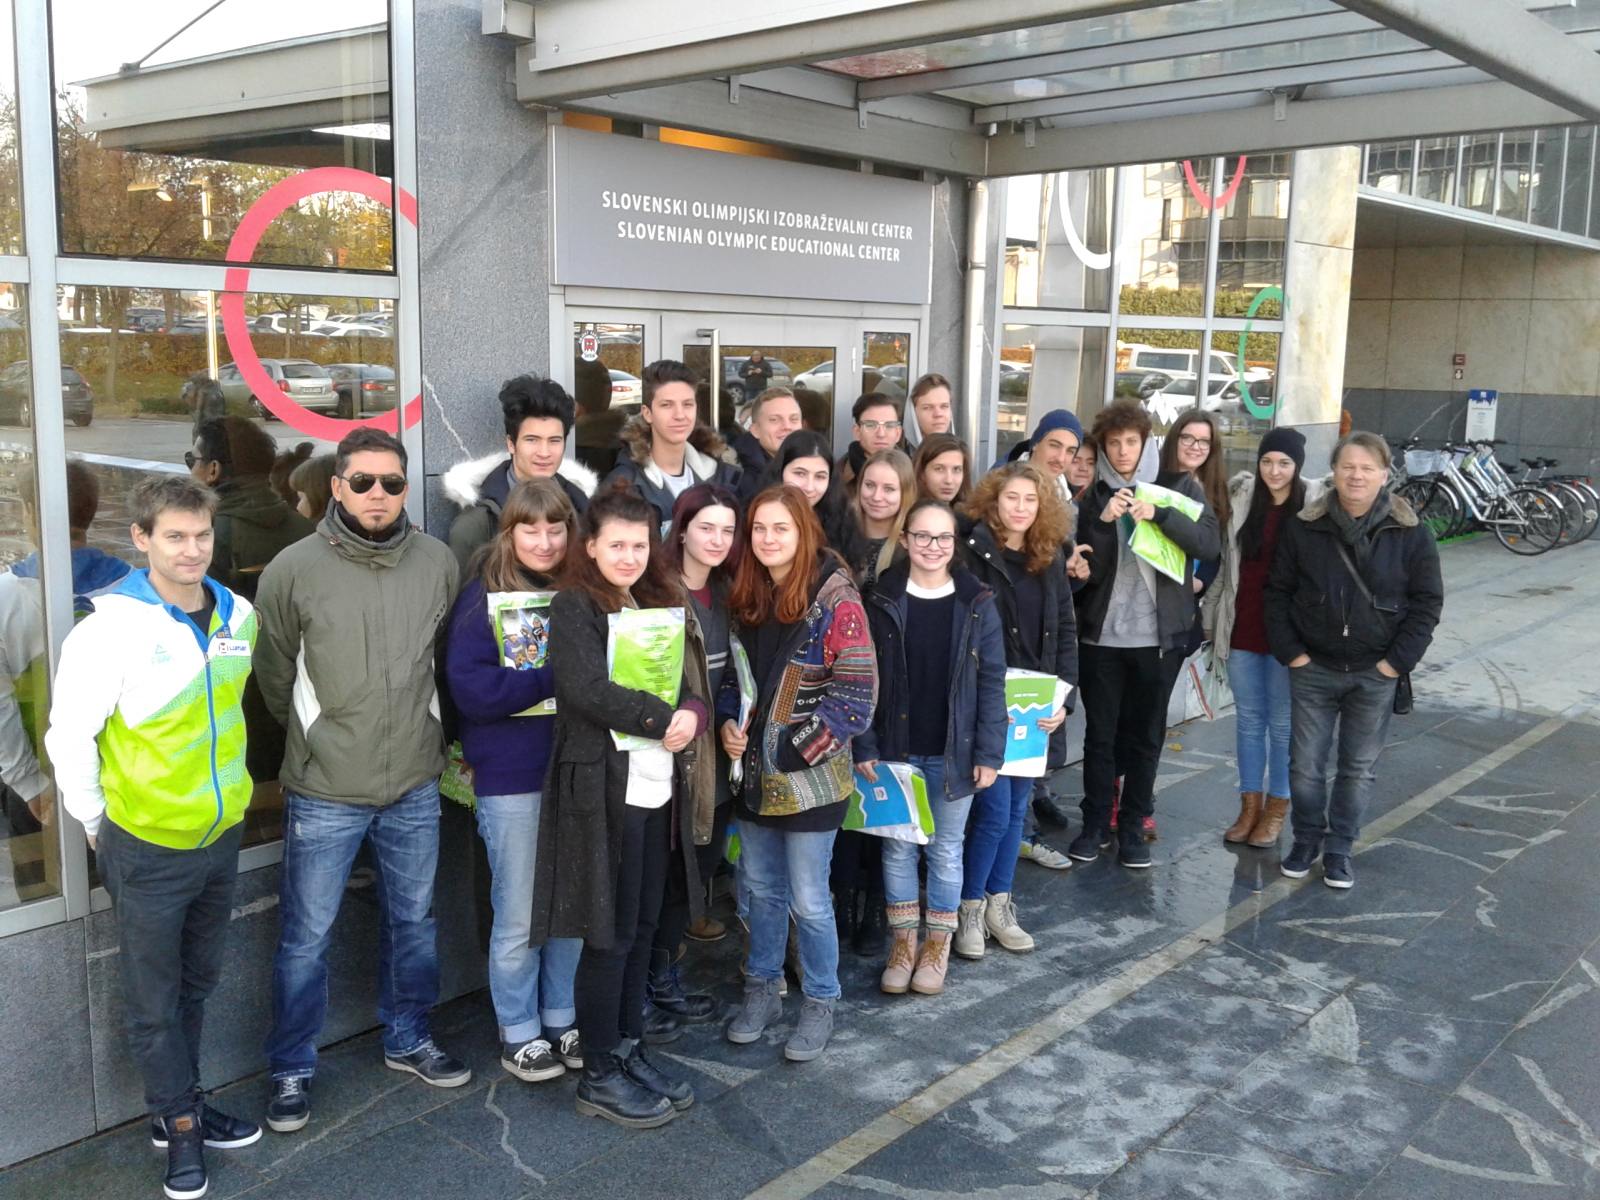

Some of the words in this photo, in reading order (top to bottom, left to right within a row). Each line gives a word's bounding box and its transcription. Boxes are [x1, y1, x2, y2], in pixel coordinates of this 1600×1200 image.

[602, 190, 688, 216] SLOVENSKI
[692, 201, 770, 226] OLIMPIJSKI
[773, 211, 869, 236] IZOBRAŽEVALNI
[871, 222, 913, 241] CENTER
[617, 220, 703, 245] SLOVENIAN
[707, 229, 768, 251] OLYMPIC
[771, 235, 856, 259] EDUCATIONAL
[858, 244, 900, 263] CENTER
